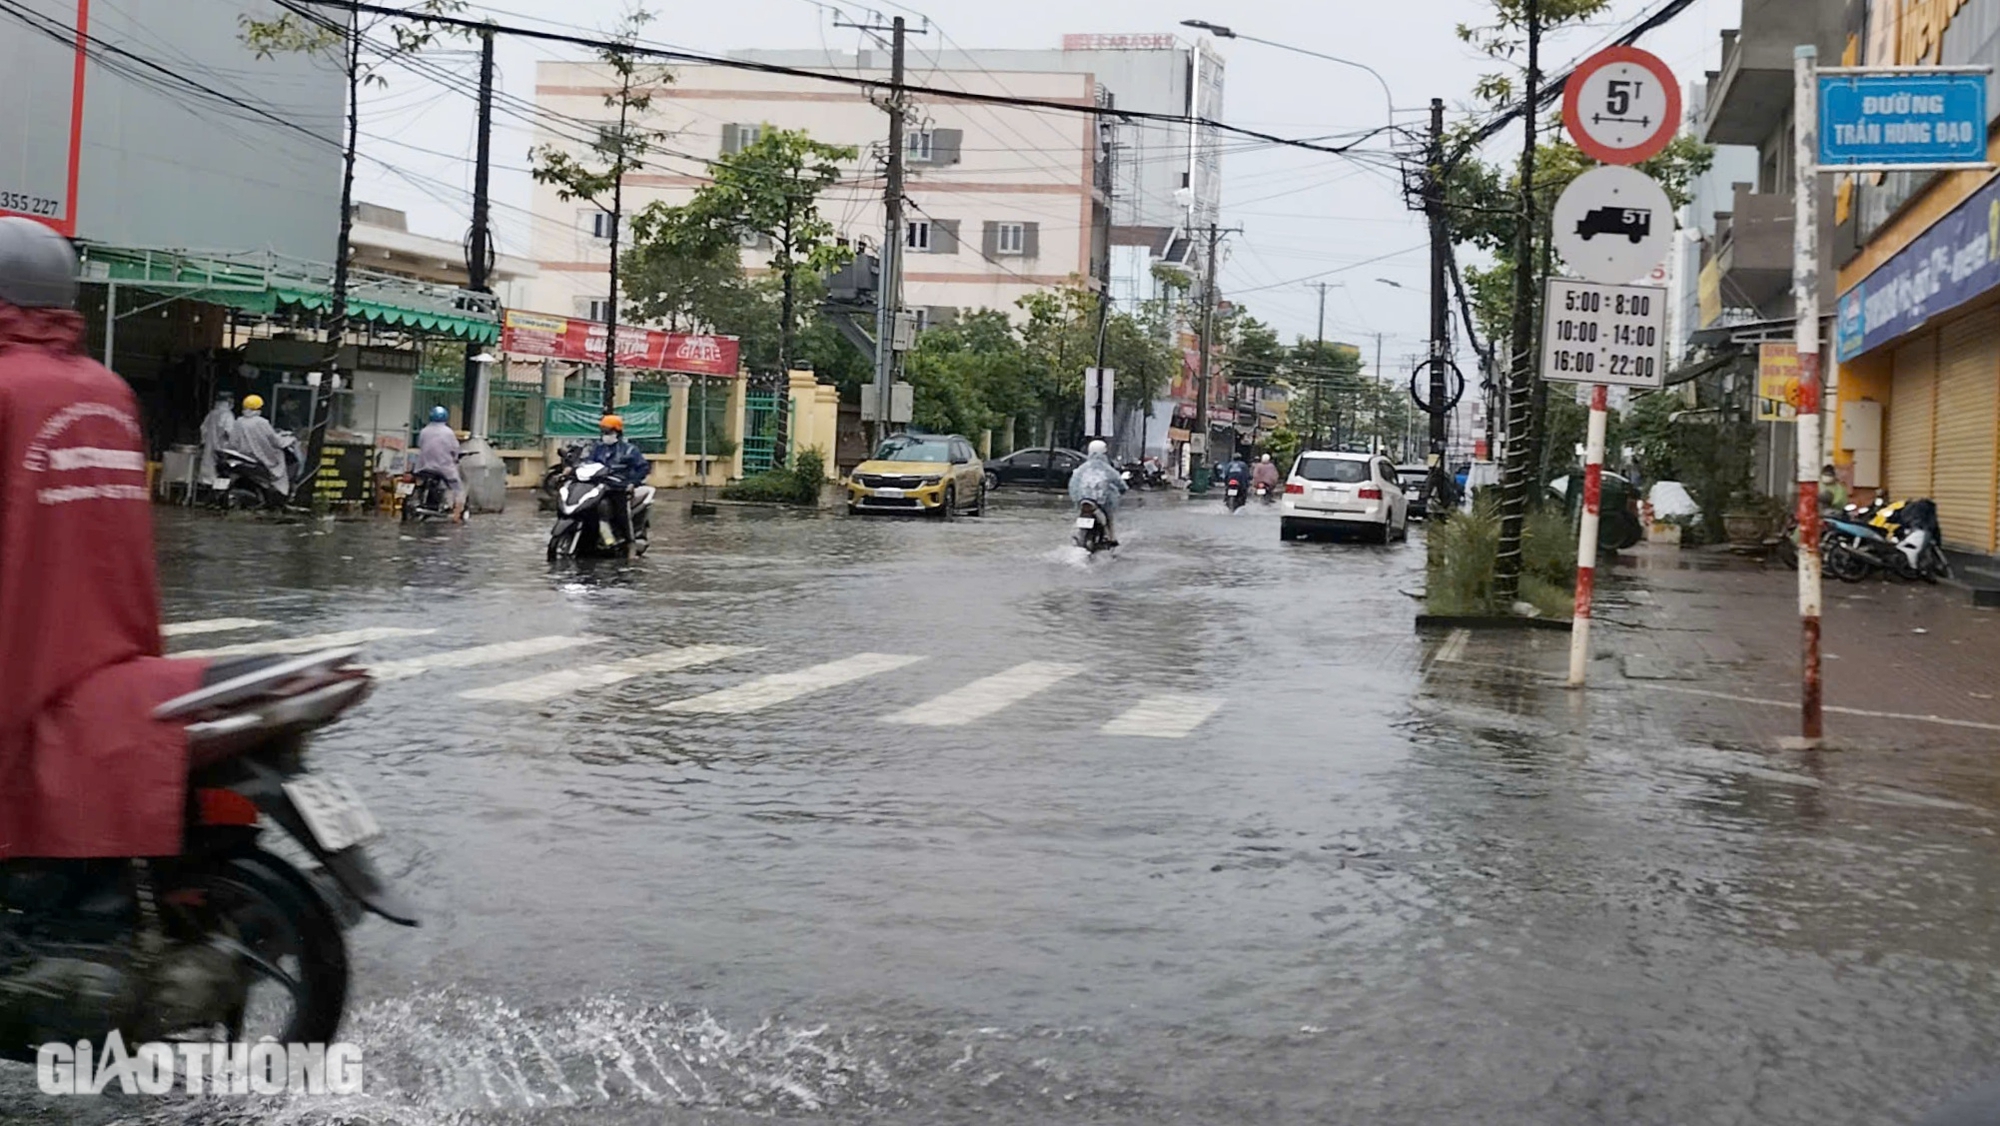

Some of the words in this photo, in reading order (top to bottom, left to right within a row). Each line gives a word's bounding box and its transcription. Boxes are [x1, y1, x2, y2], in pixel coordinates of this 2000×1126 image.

[1862, 91, 1944, 114] ĐƯỜNG
[1884, 119, 1931, 144] HƯNG
[1935, 121, 1973, 148] ĐẠO
[1, 191, 28, 211] 355
[32, 198, 58, 216] 227
[1622, 209, 1650, 225] 5T
[1565, 290, 1599, 312] 5:00
[1615, 294, 1650, 316] 8:00
[1557, 320, 1597, 343] 10:00
[1614, 324, 1655, 347] 14:00
[1554, 350, 1594, 373] 16:00
[1610, 354, 1654, 377] 22:00
